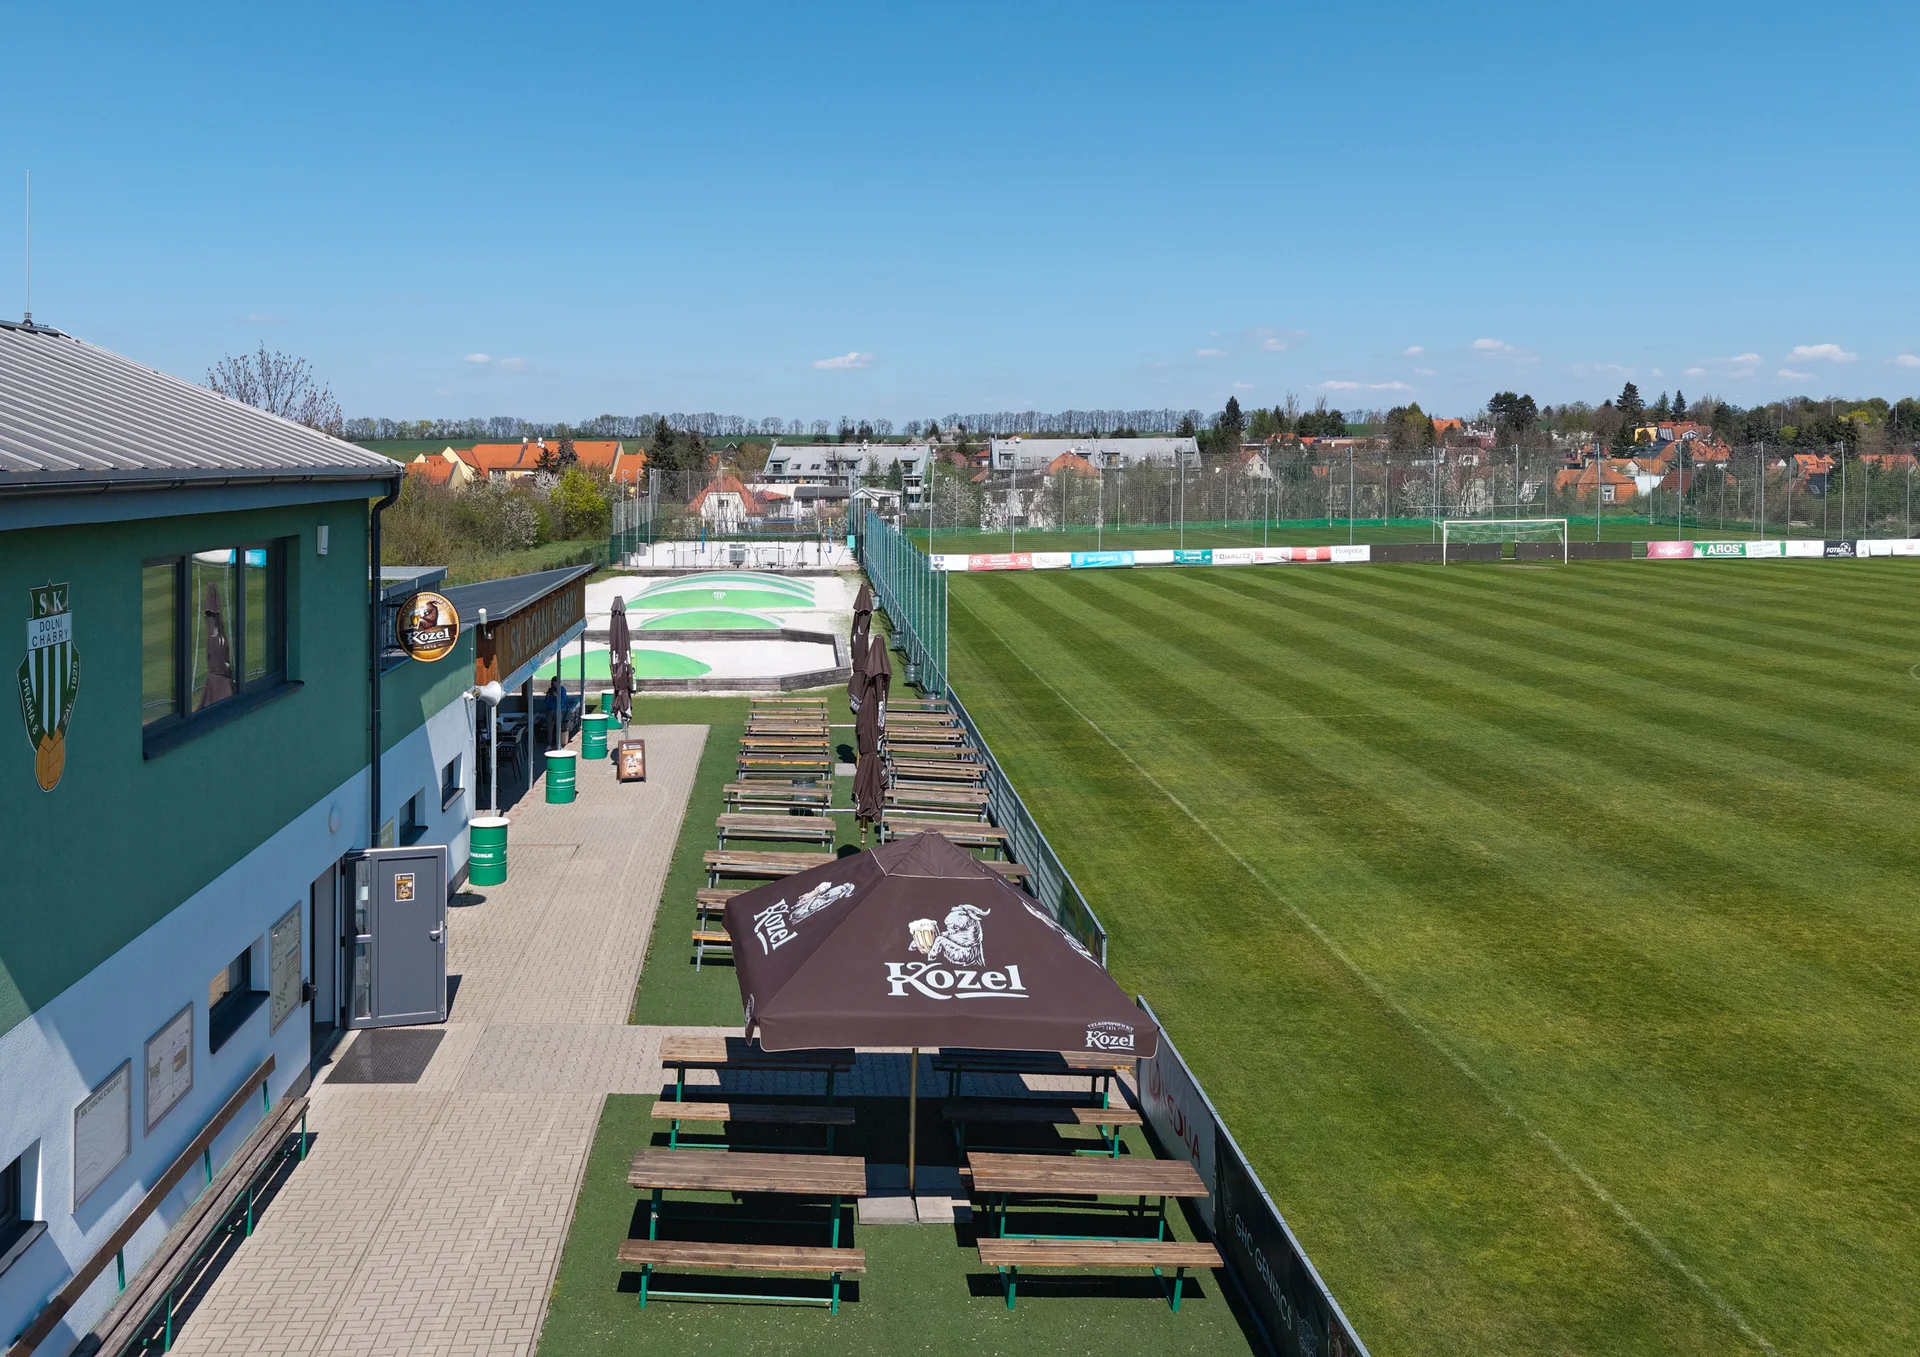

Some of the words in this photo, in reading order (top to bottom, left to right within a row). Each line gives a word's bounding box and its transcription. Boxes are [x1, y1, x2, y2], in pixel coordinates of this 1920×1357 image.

[32, 629, 69, 647] CHABRY
[40, 615, 63, 632] DOLNÍ
[406, 628, 450, 645] Kozel
[510, 621, 523, 666] SK
[552, 588, 577, 634] CHABRY
[22, 677, 35, 725] PRAHA
[32, 724, 39, 735] 8
[753, 899, 798, 955] Kozel
[884, 962, 1029, 1000] Kozel
[1085, 1031, 1134, 1050] Kozel
[1235, 1213, 1253, 1257] GHC
[1254, 1247, 1292, 1331] GENETICS
